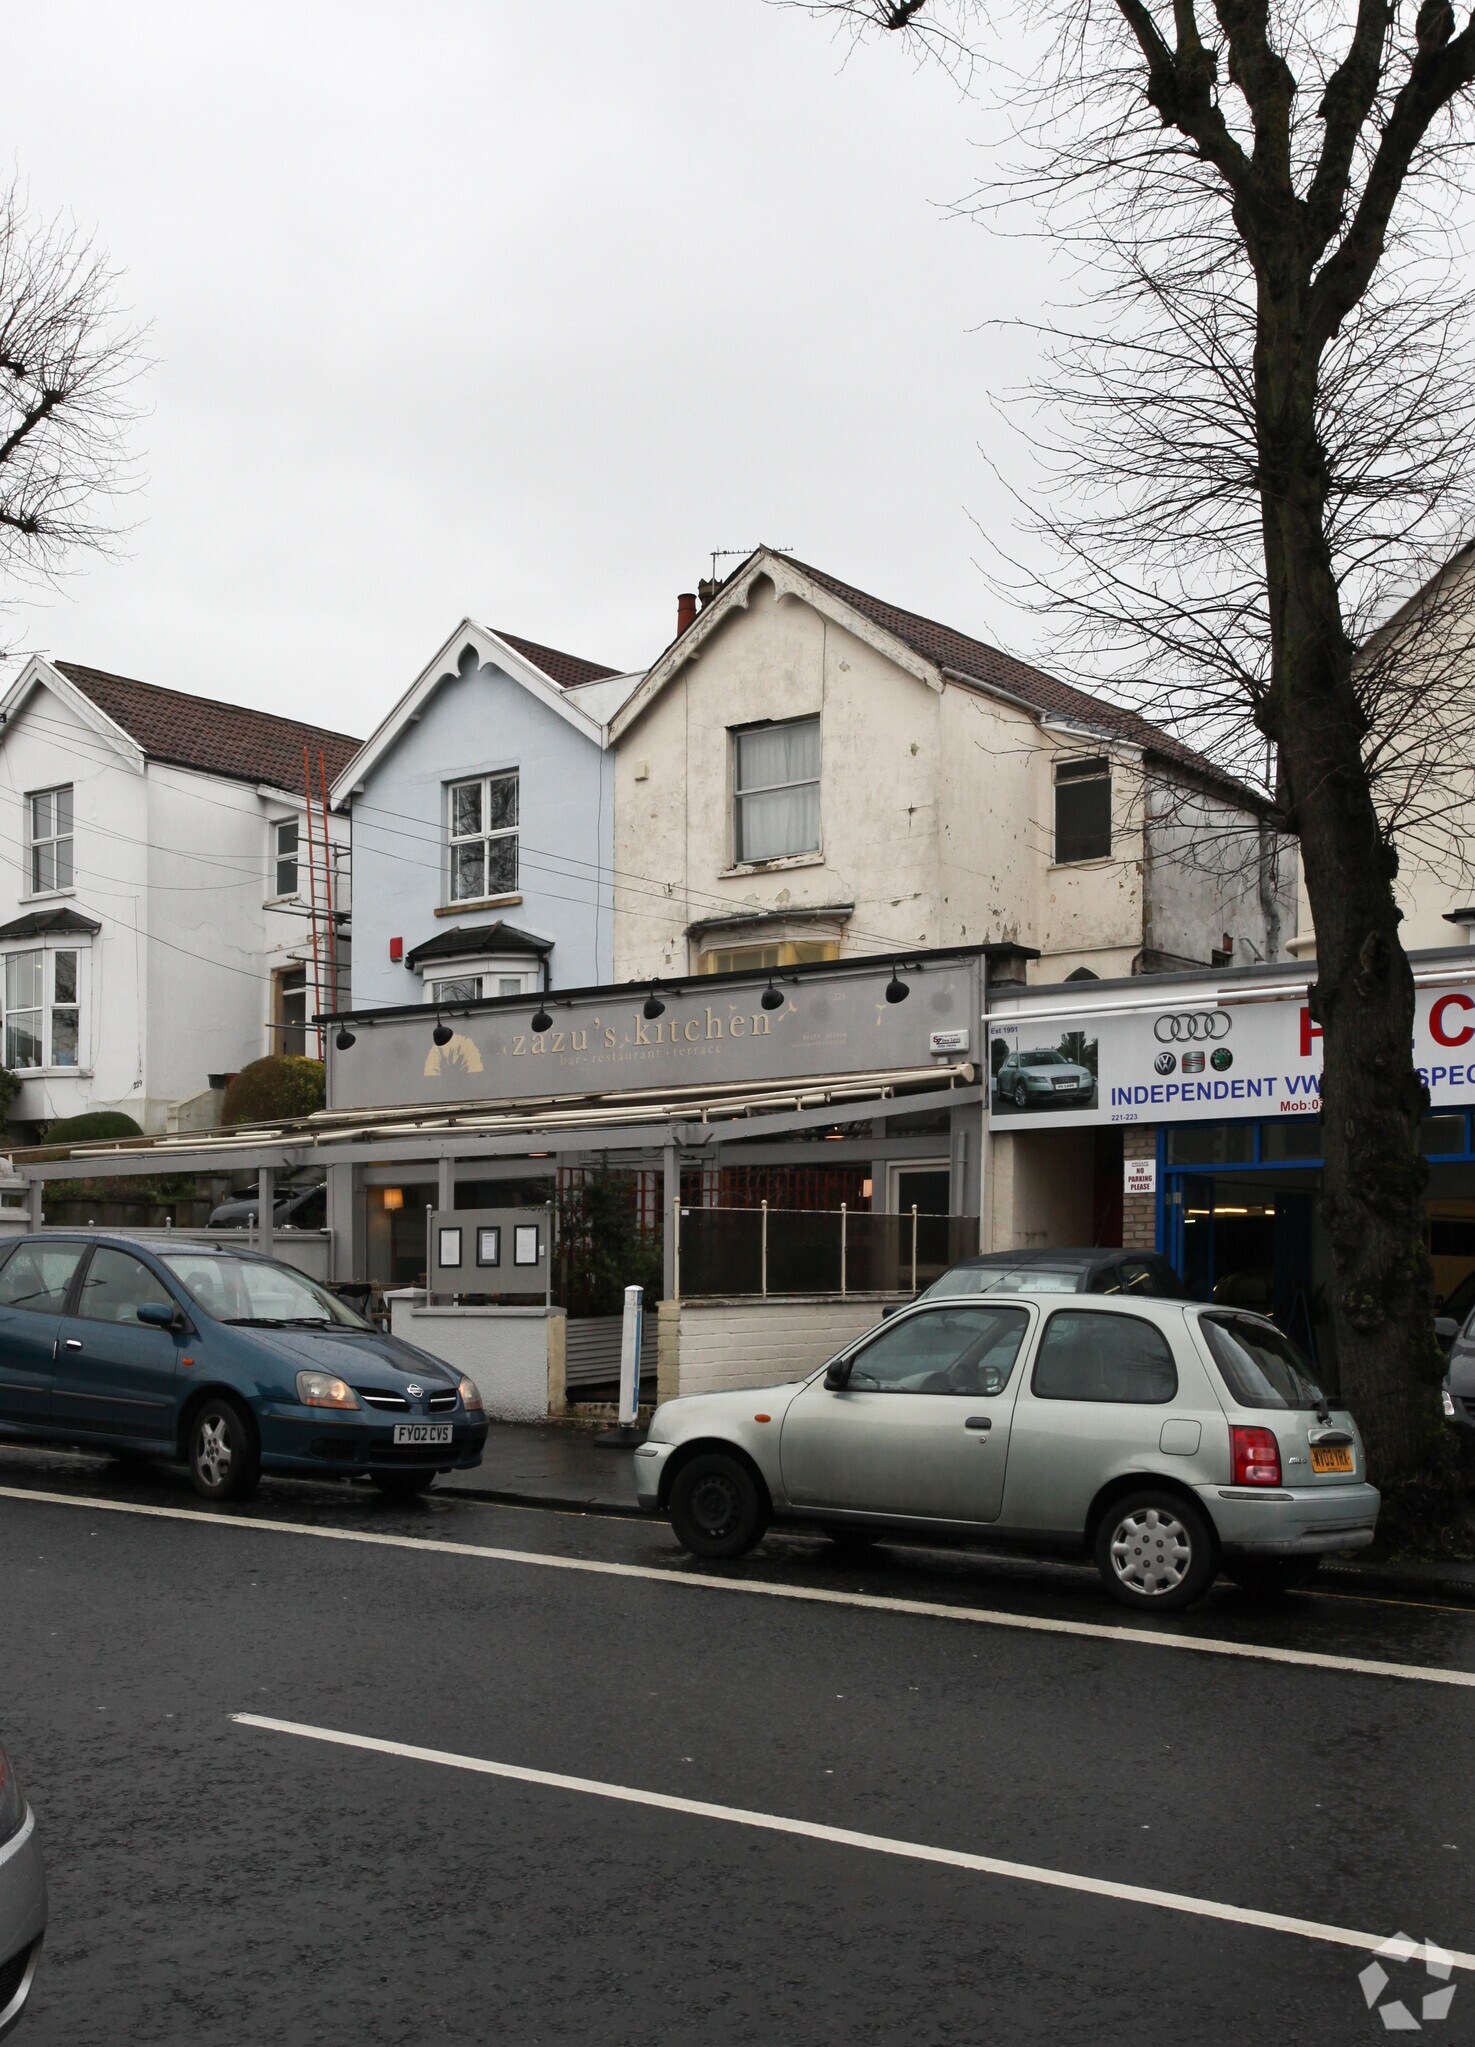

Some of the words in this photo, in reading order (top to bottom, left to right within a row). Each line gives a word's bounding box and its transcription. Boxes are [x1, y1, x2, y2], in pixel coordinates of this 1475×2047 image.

[511, 1017, 616, 1057] zazu's
[632, 1007, 772, 1047] kitchen
[1003, 1026, 1018, 1034] 1991
[560, 1054, 581, 1066] bar
[592, 1050, 661, 1064] restaurant
[673, 1043, 722, 1056] terrace
[1111, 1076, 1278, 1106] INDEPENDENT
[399, 1427, 427, 1441] FY02
[430, 1427, 448, 1441] CVS
